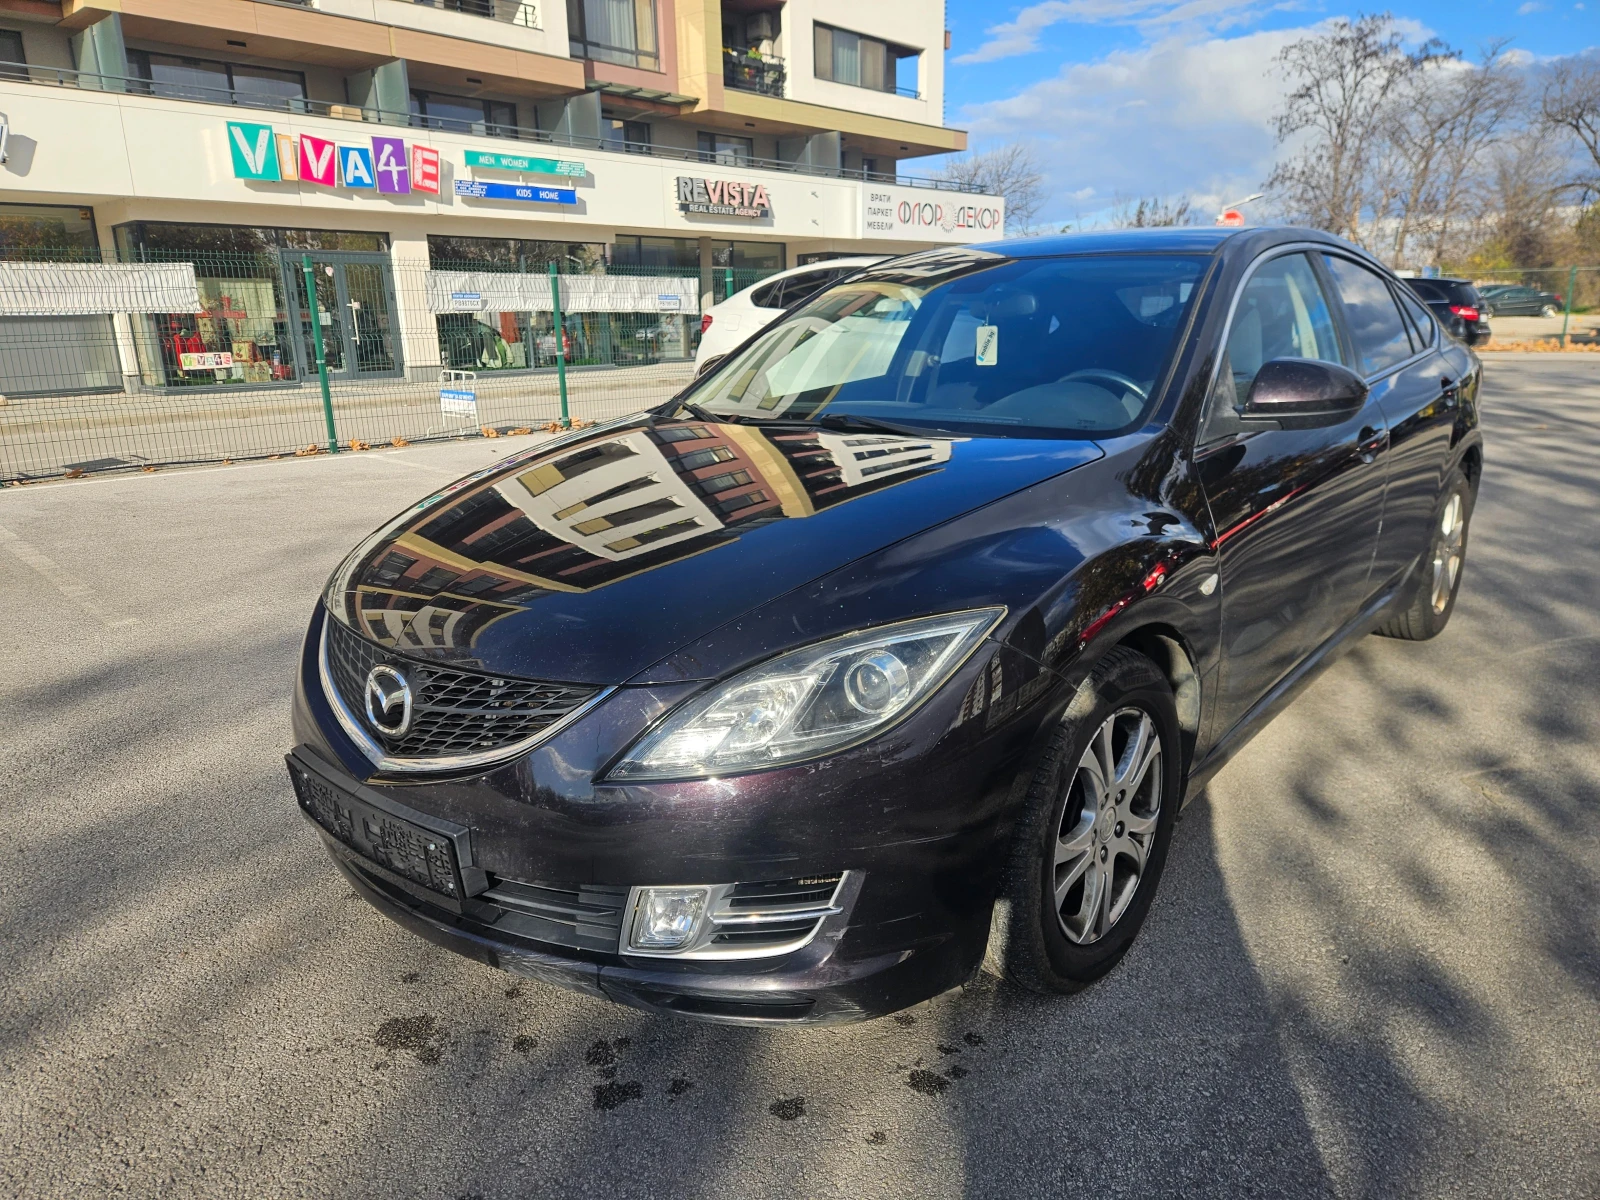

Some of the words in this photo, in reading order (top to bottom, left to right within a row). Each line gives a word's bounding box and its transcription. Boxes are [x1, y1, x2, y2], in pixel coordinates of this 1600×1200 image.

[229, 126, 438, 192] VIVA4E
[479, 155, 495, 165] MEN
[500, 157, 529, 168] WOMEN
[516, 188, 532, 198] KIDS
[539, 190, 559, 200] HOME
[677, 176, 770, 208] REVISTA
[870, 193, 891, 203] ВРАТИ
[689, 204, 708, 213] REAL
[709, 206, 734, 215] ESTATE
[735, 208, 761, 217] AGENCY
[867, 207, 893, 217] ПАРКЕТ
[866, 220, 894, 231] МЕБЕЛИ
